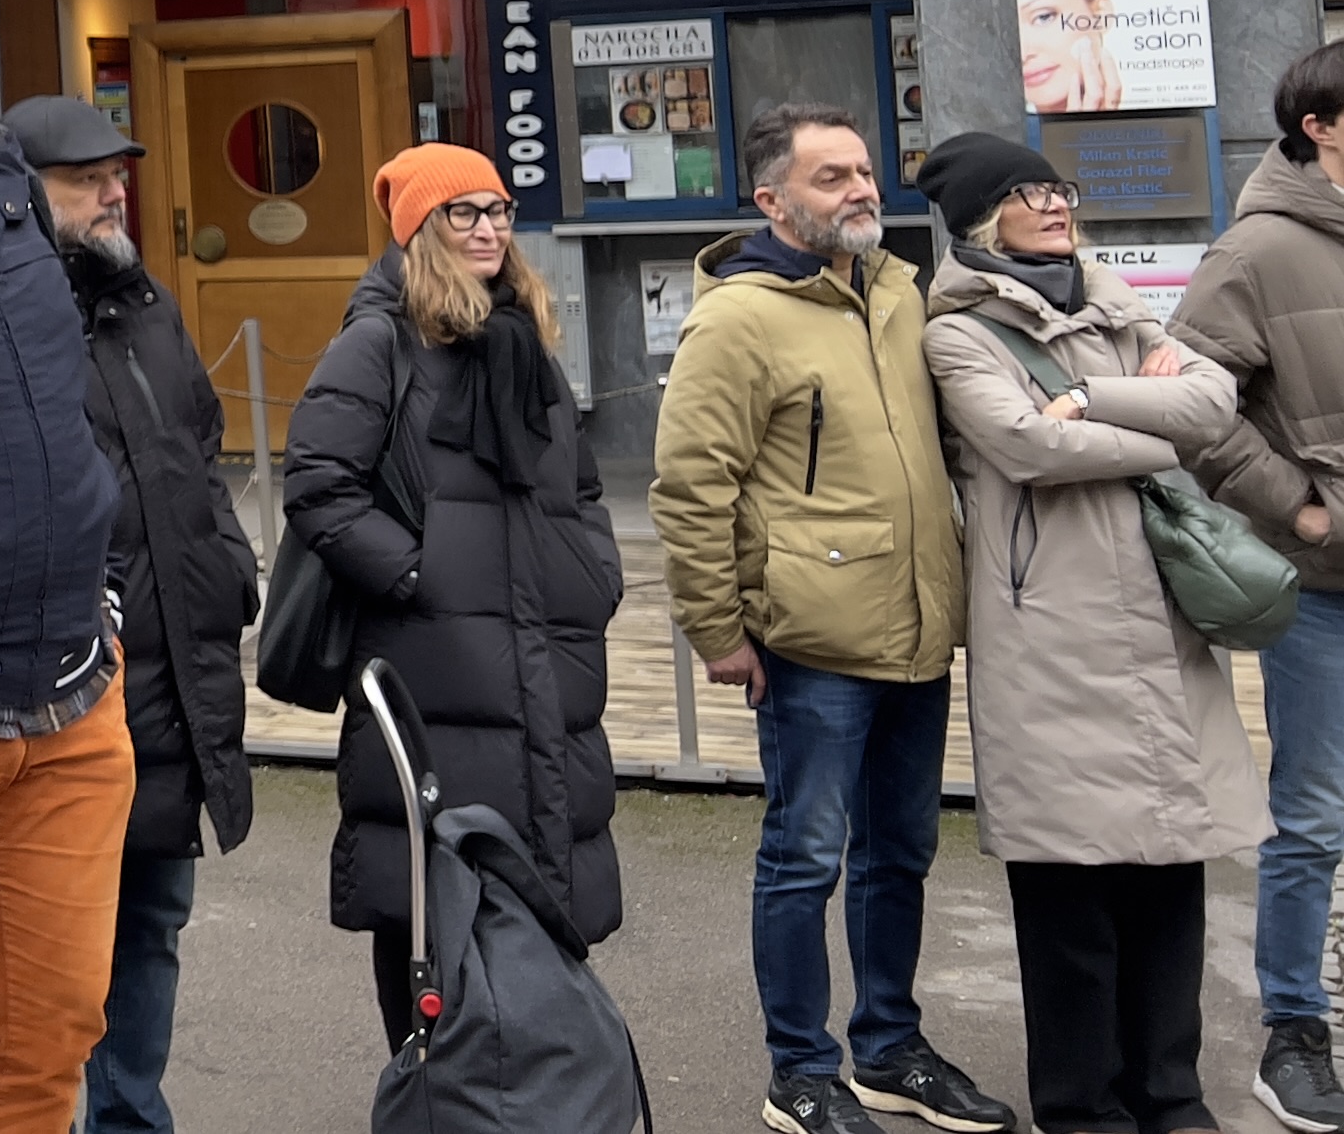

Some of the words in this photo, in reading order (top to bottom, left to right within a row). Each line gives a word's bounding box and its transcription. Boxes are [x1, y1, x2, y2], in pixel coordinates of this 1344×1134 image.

[1061, 5, 1201, 32] Kozmetični
[1134, 30, 1202, 52] salon
[505, 89, 546, 188] FOOD
[1079, 149, 1121, 162] Milan
